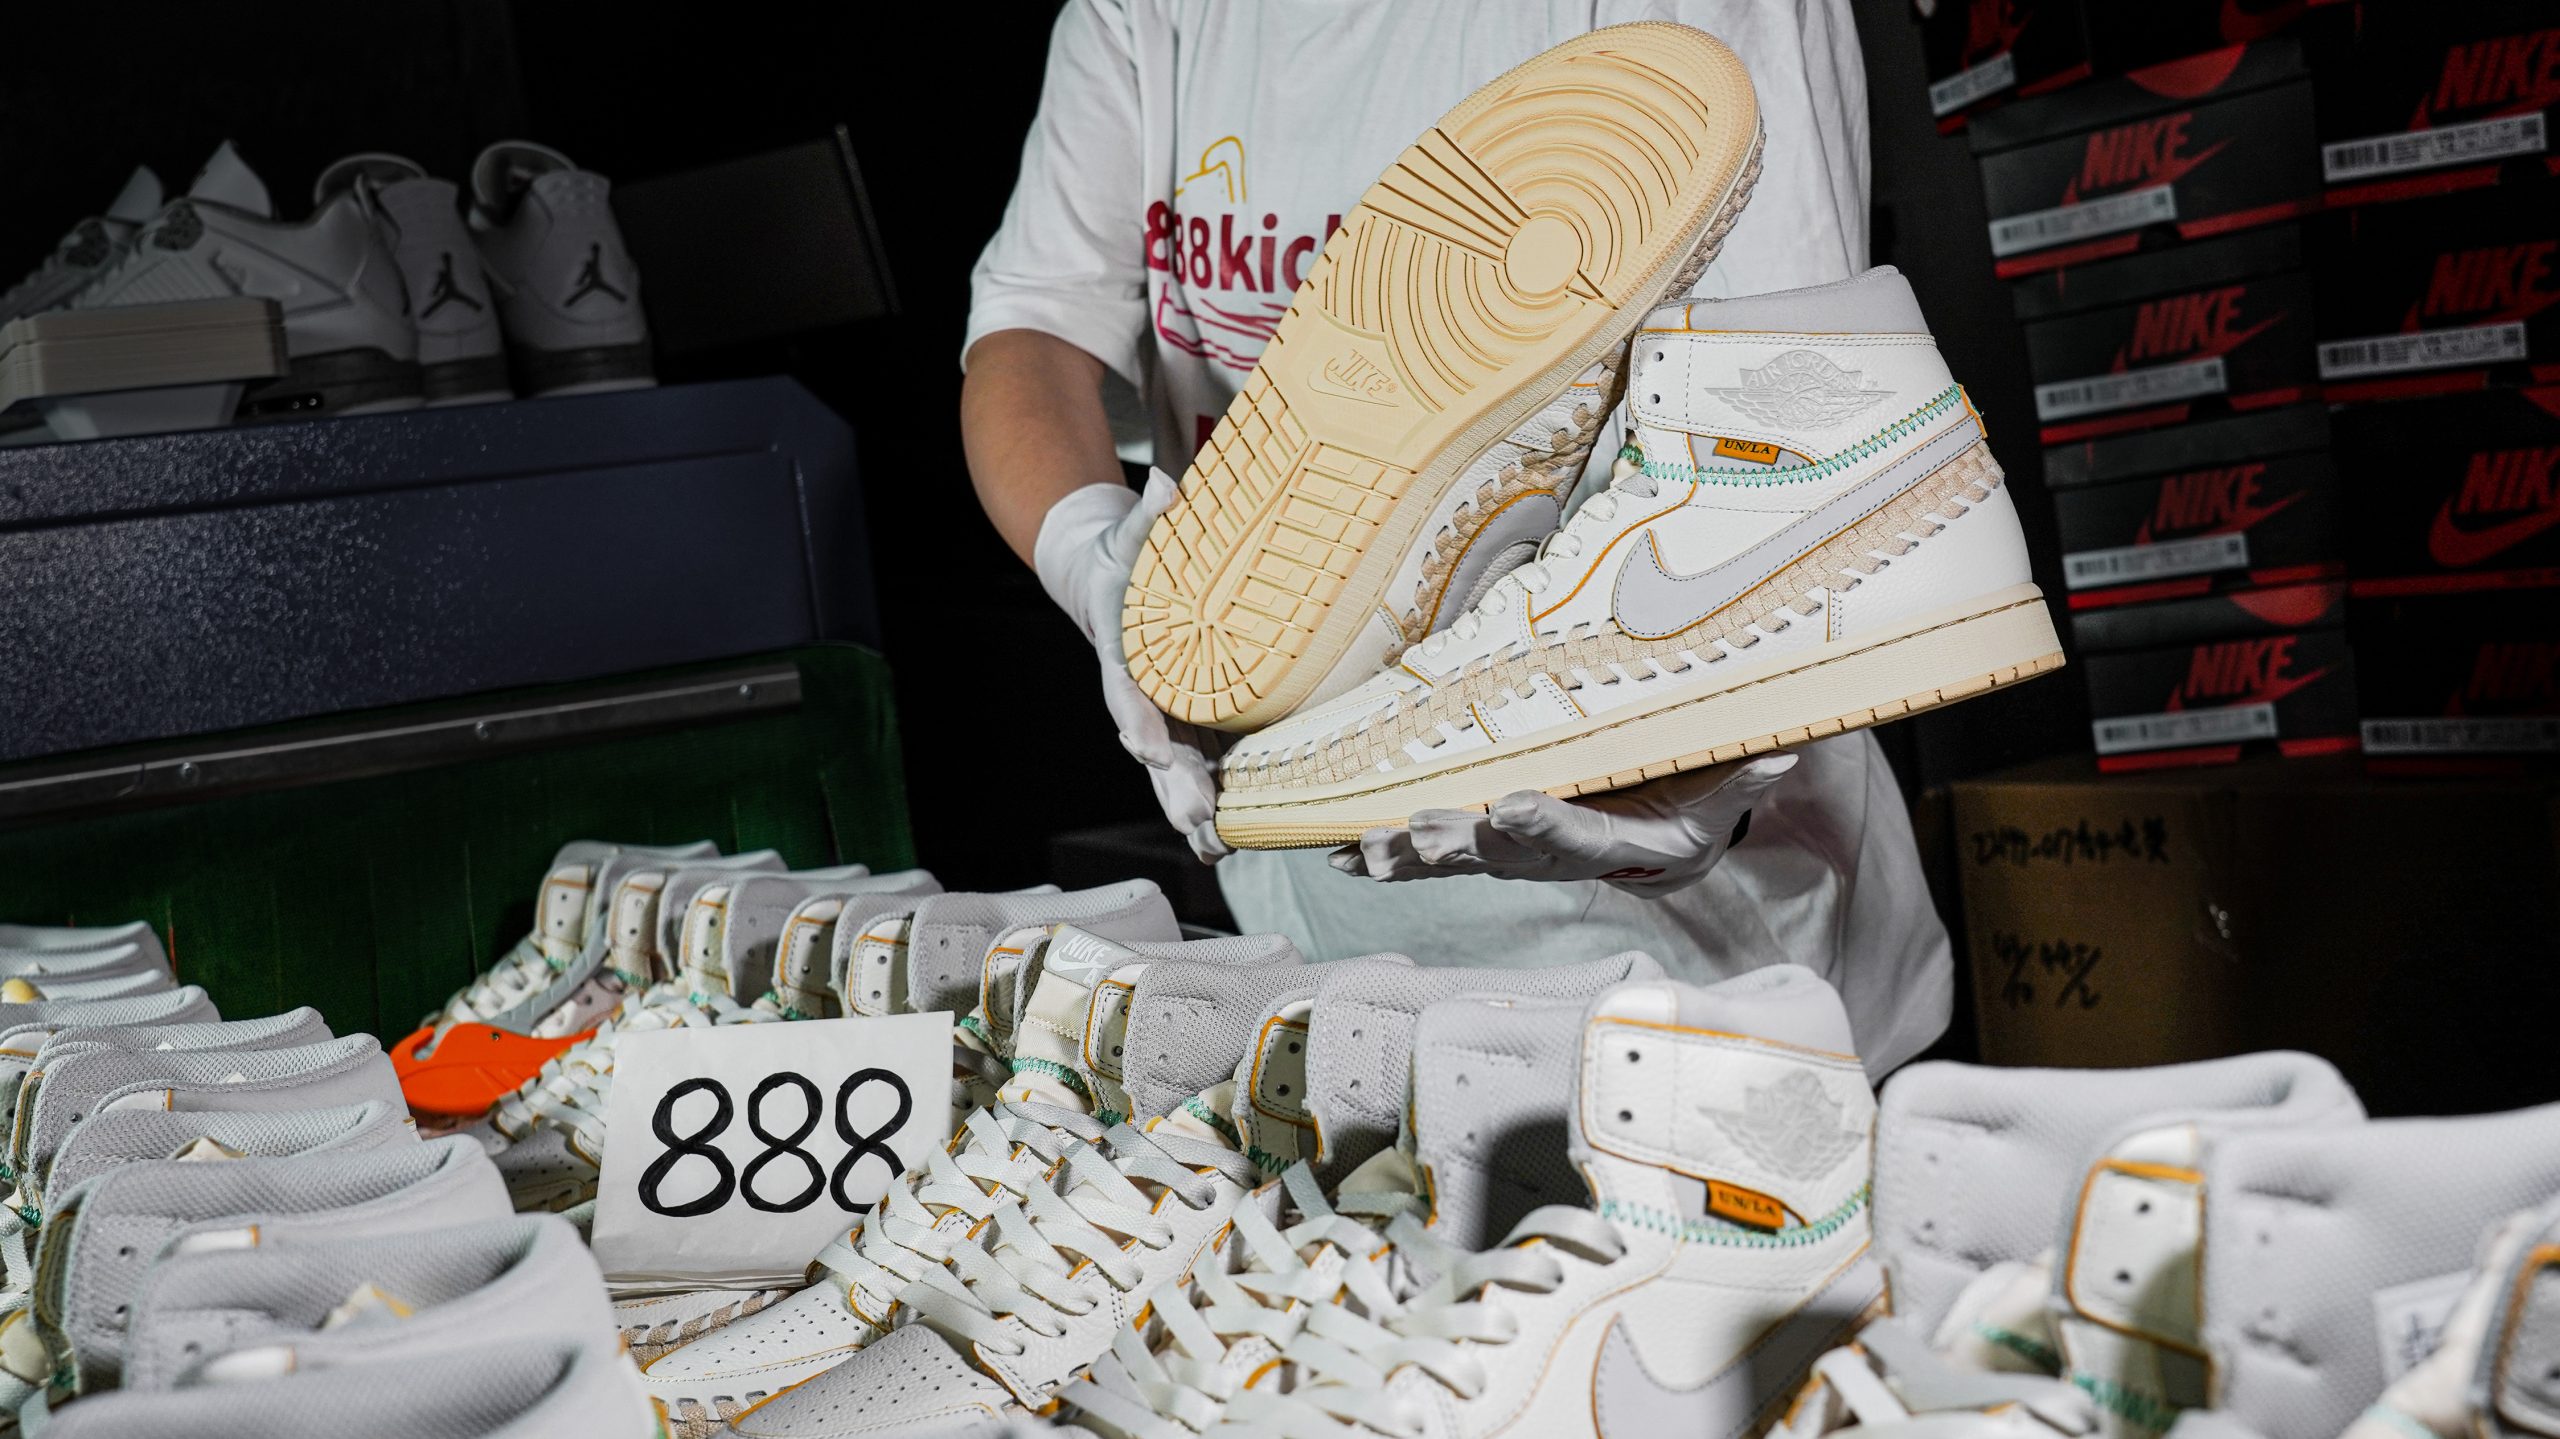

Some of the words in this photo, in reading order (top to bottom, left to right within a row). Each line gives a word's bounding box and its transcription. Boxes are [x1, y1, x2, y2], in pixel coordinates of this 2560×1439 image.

[2081, 112, 2193, 191] NIKE
[1145, 200, 1342, 293] 888kic
[2423, 239, 2559, 317] NIKE
[2130, 285, 2247, 361] NIKE
[1746, 363, 1783, 387] AIR
[1724, 440, 1770, 454] UN/LA
[2456, 443, 2560, 516] NIK
[2154, 462, 2267, 533] NIKE
[2184, 634, 2298, 699] NIKE
[1062, 934, 1112, 963] NIKE
[638, 1067, 912, 1217] 888
